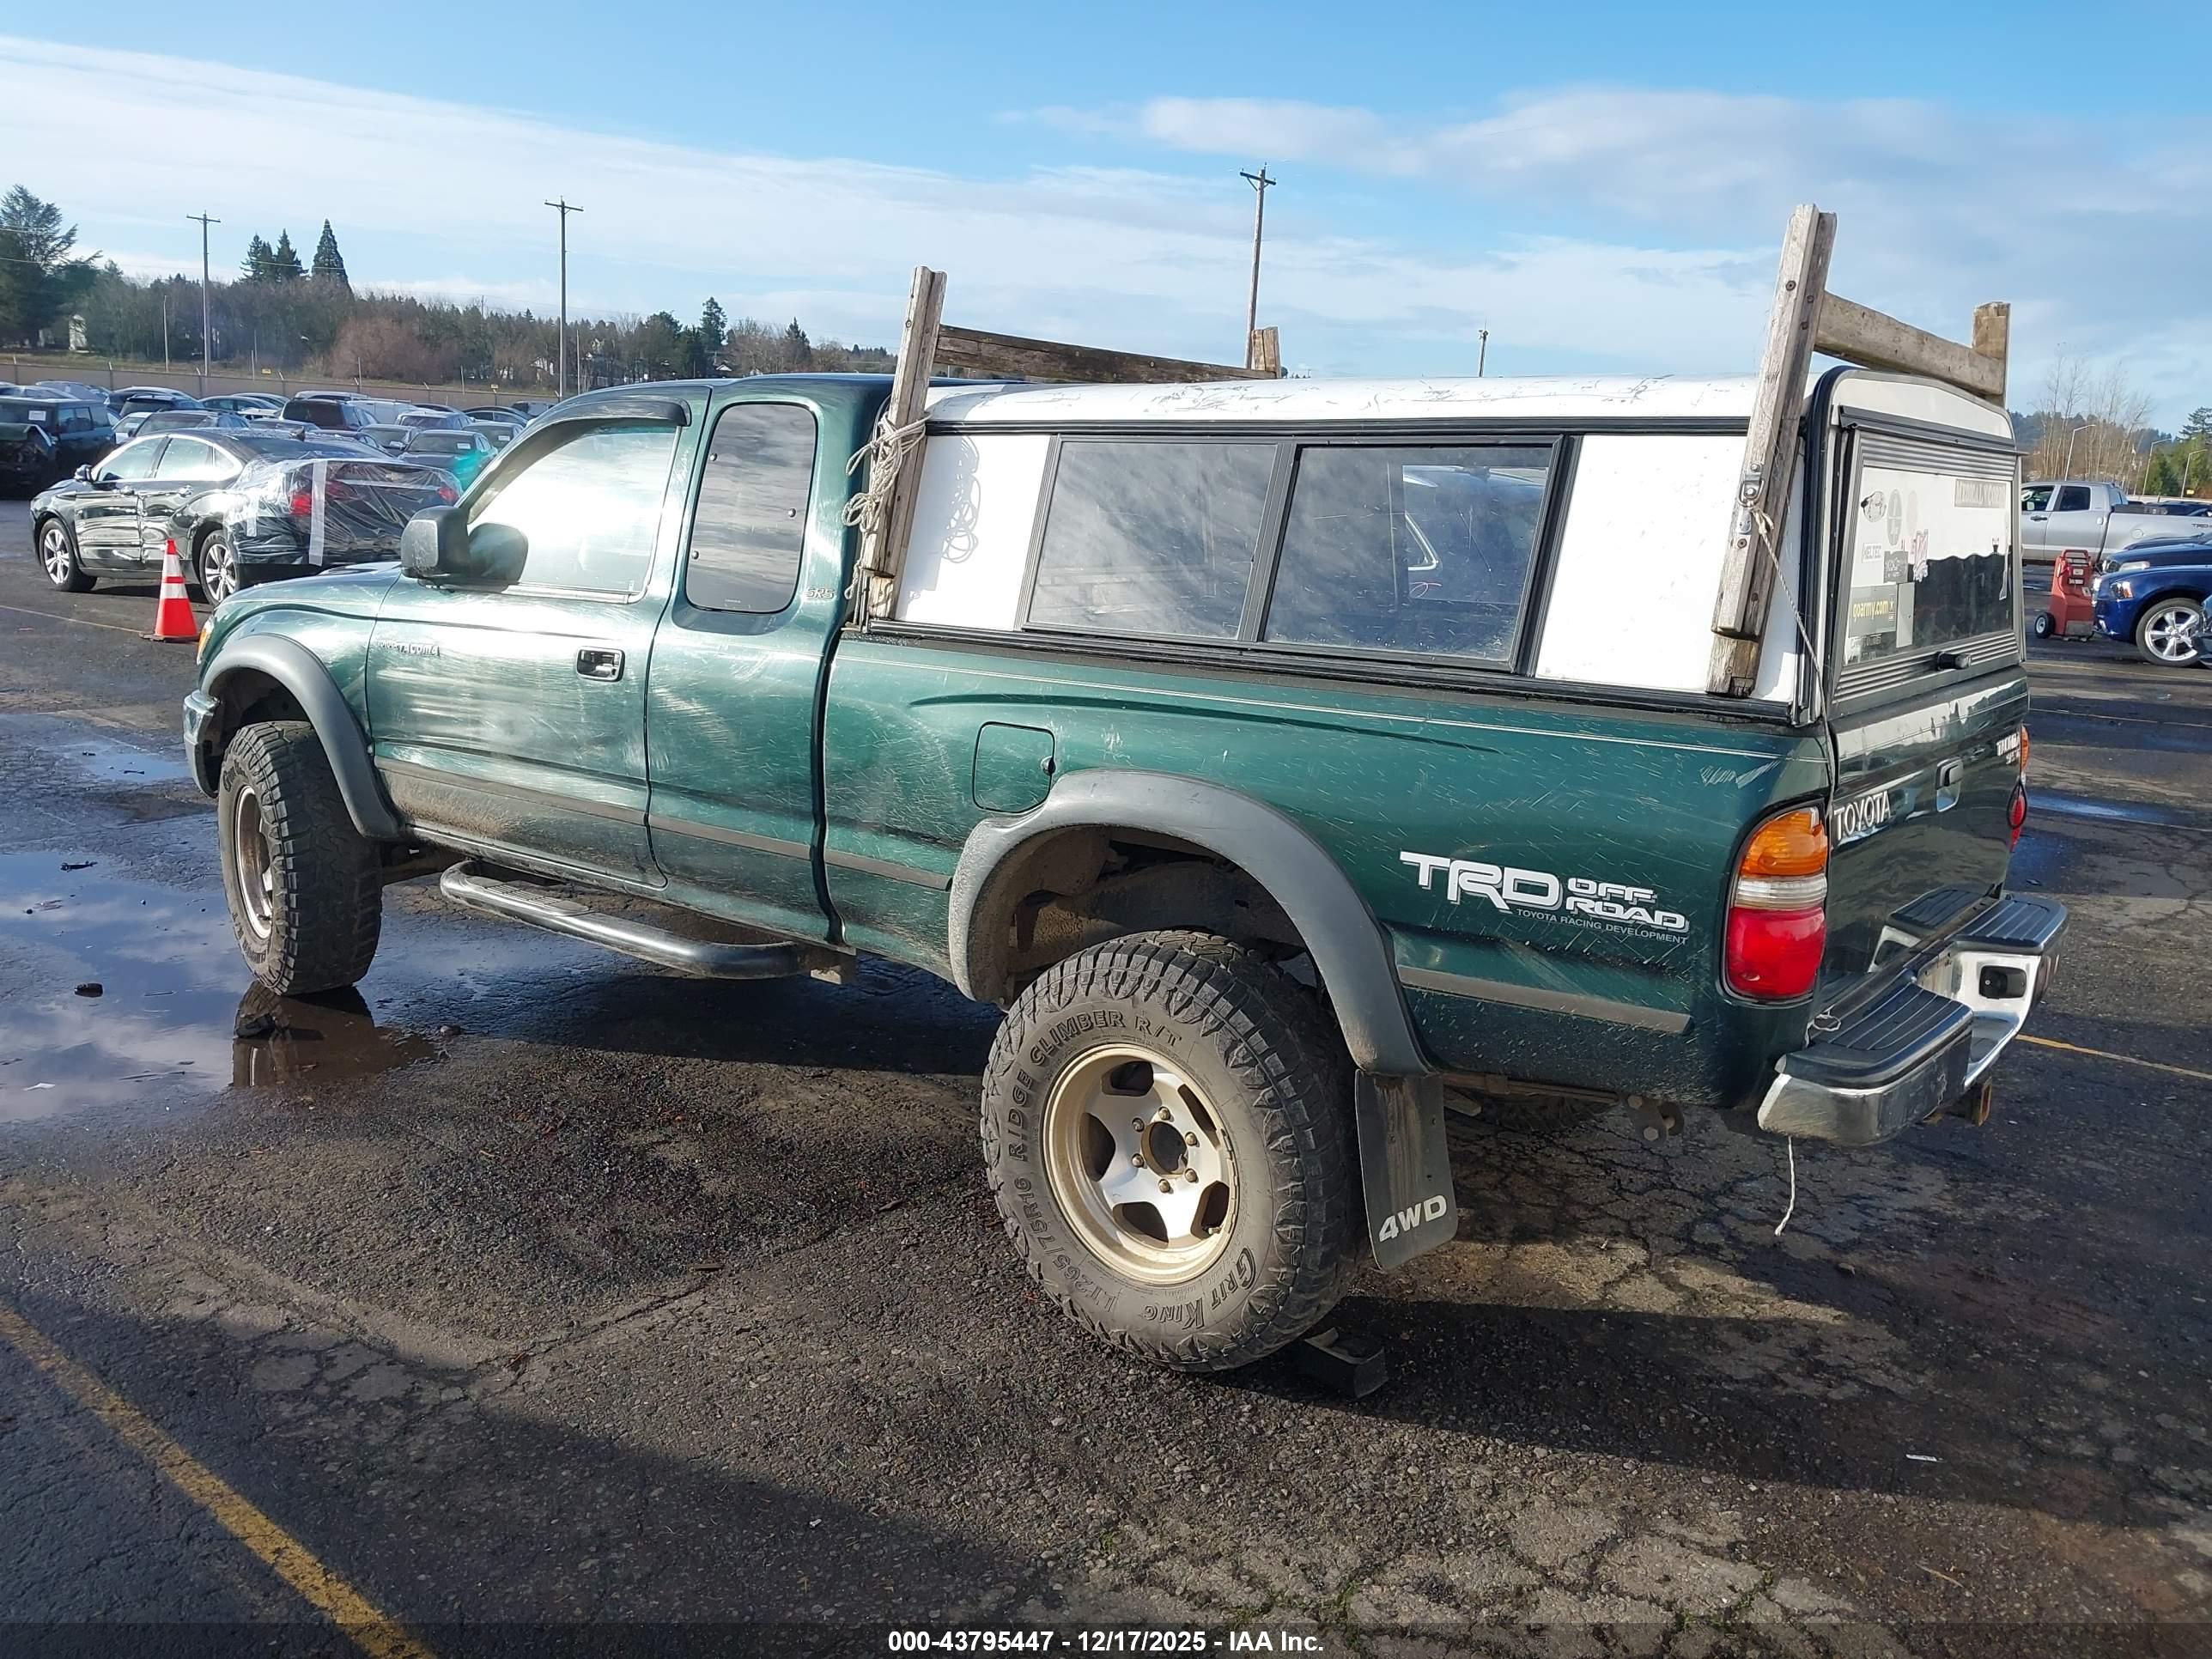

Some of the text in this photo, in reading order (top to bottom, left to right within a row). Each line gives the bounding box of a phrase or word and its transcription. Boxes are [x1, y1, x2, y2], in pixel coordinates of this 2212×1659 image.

[1853, 600, 1888, 623] goarmy.com
[1833, 791, 1890, 841] TOYOTA
[1400, 851, 1563, 913] TRD
[1567, 878, 1658, 905] OFF
[1517, 908, 1689, 945] TOYOTA RACING DEVELOPMENT
[1565, 896, 1690, 933] ROAD
[1008, 1010, 1182, 1161] RIDGE CLIMBER R/T
[1379, 1194, 1447, 1243] 4WD
